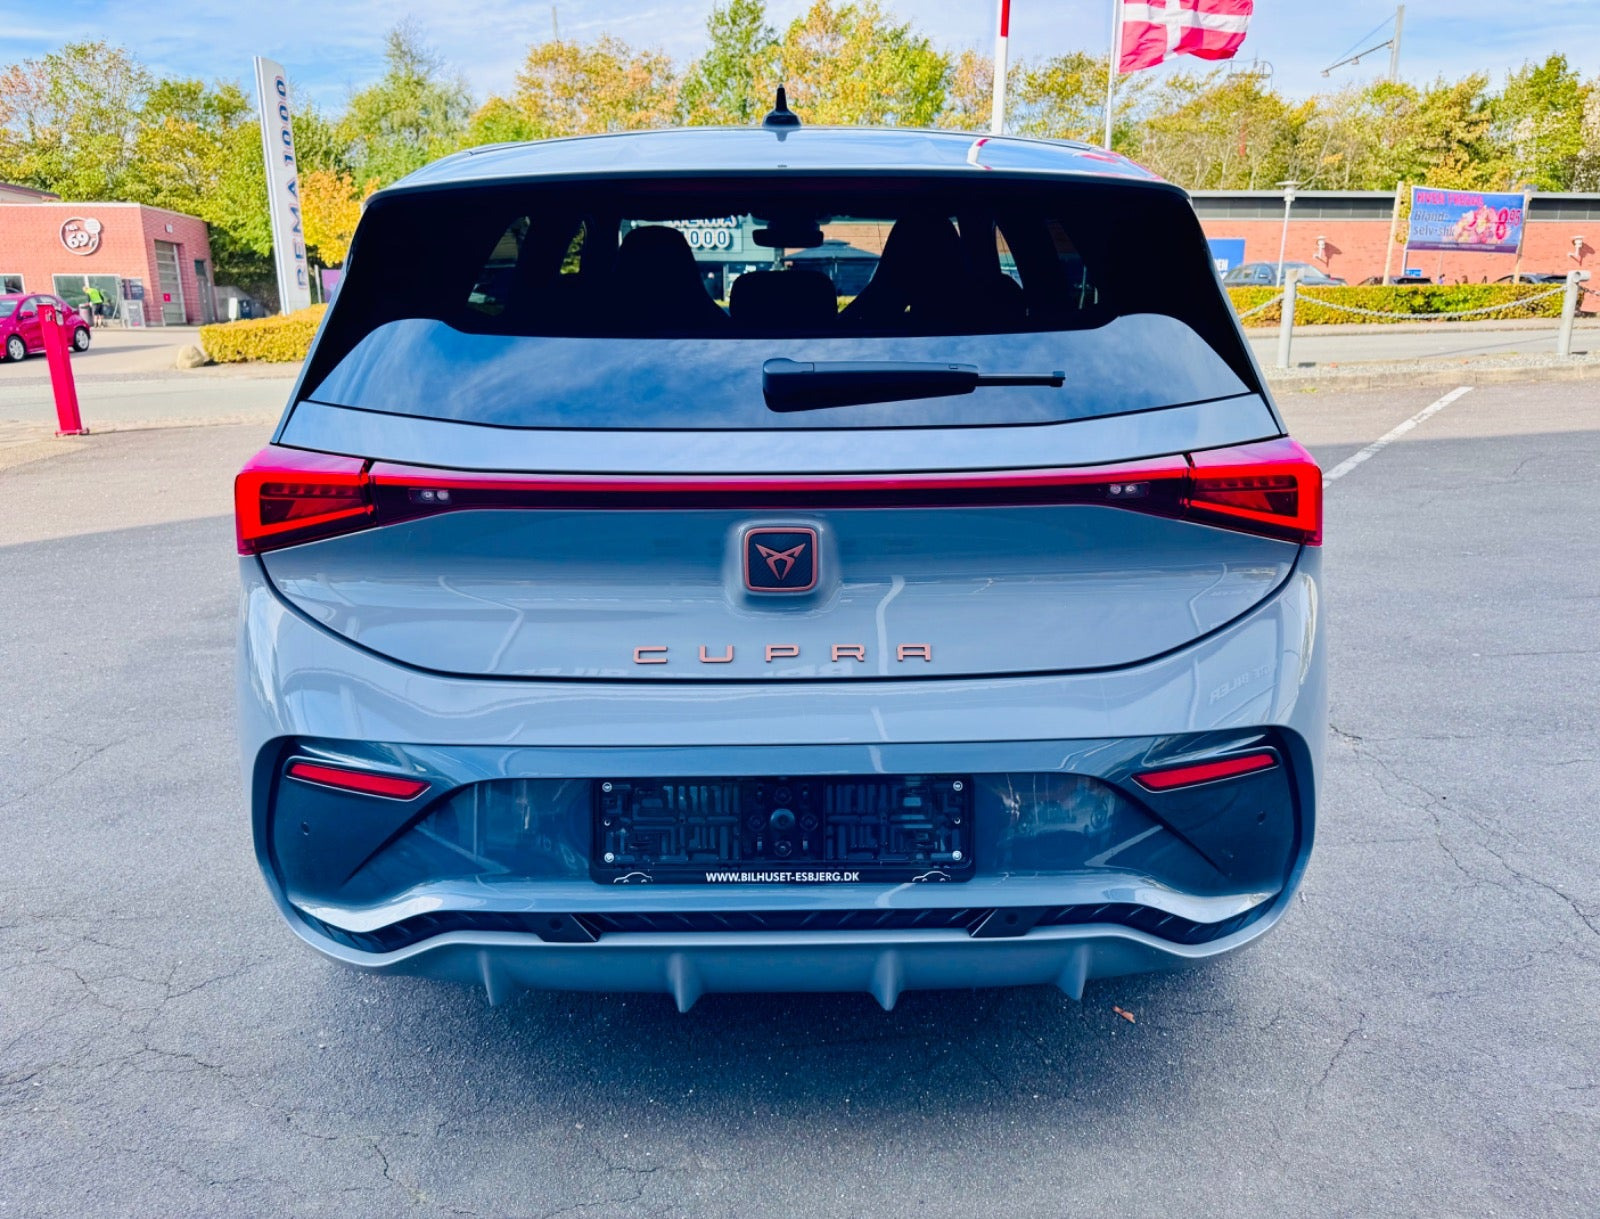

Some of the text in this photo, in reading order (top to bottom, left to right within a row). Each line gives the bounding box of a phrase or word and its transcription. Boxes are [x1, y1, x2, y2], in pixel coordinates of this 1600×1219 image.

[275, 76, 306, 288] REMA 1000
[685, 228, 731, 248] 000
[633, 643, 932, 664] CUPRA
[705, 871, 860, 883] WWW.BILHUSET-ESBJERG.DK
